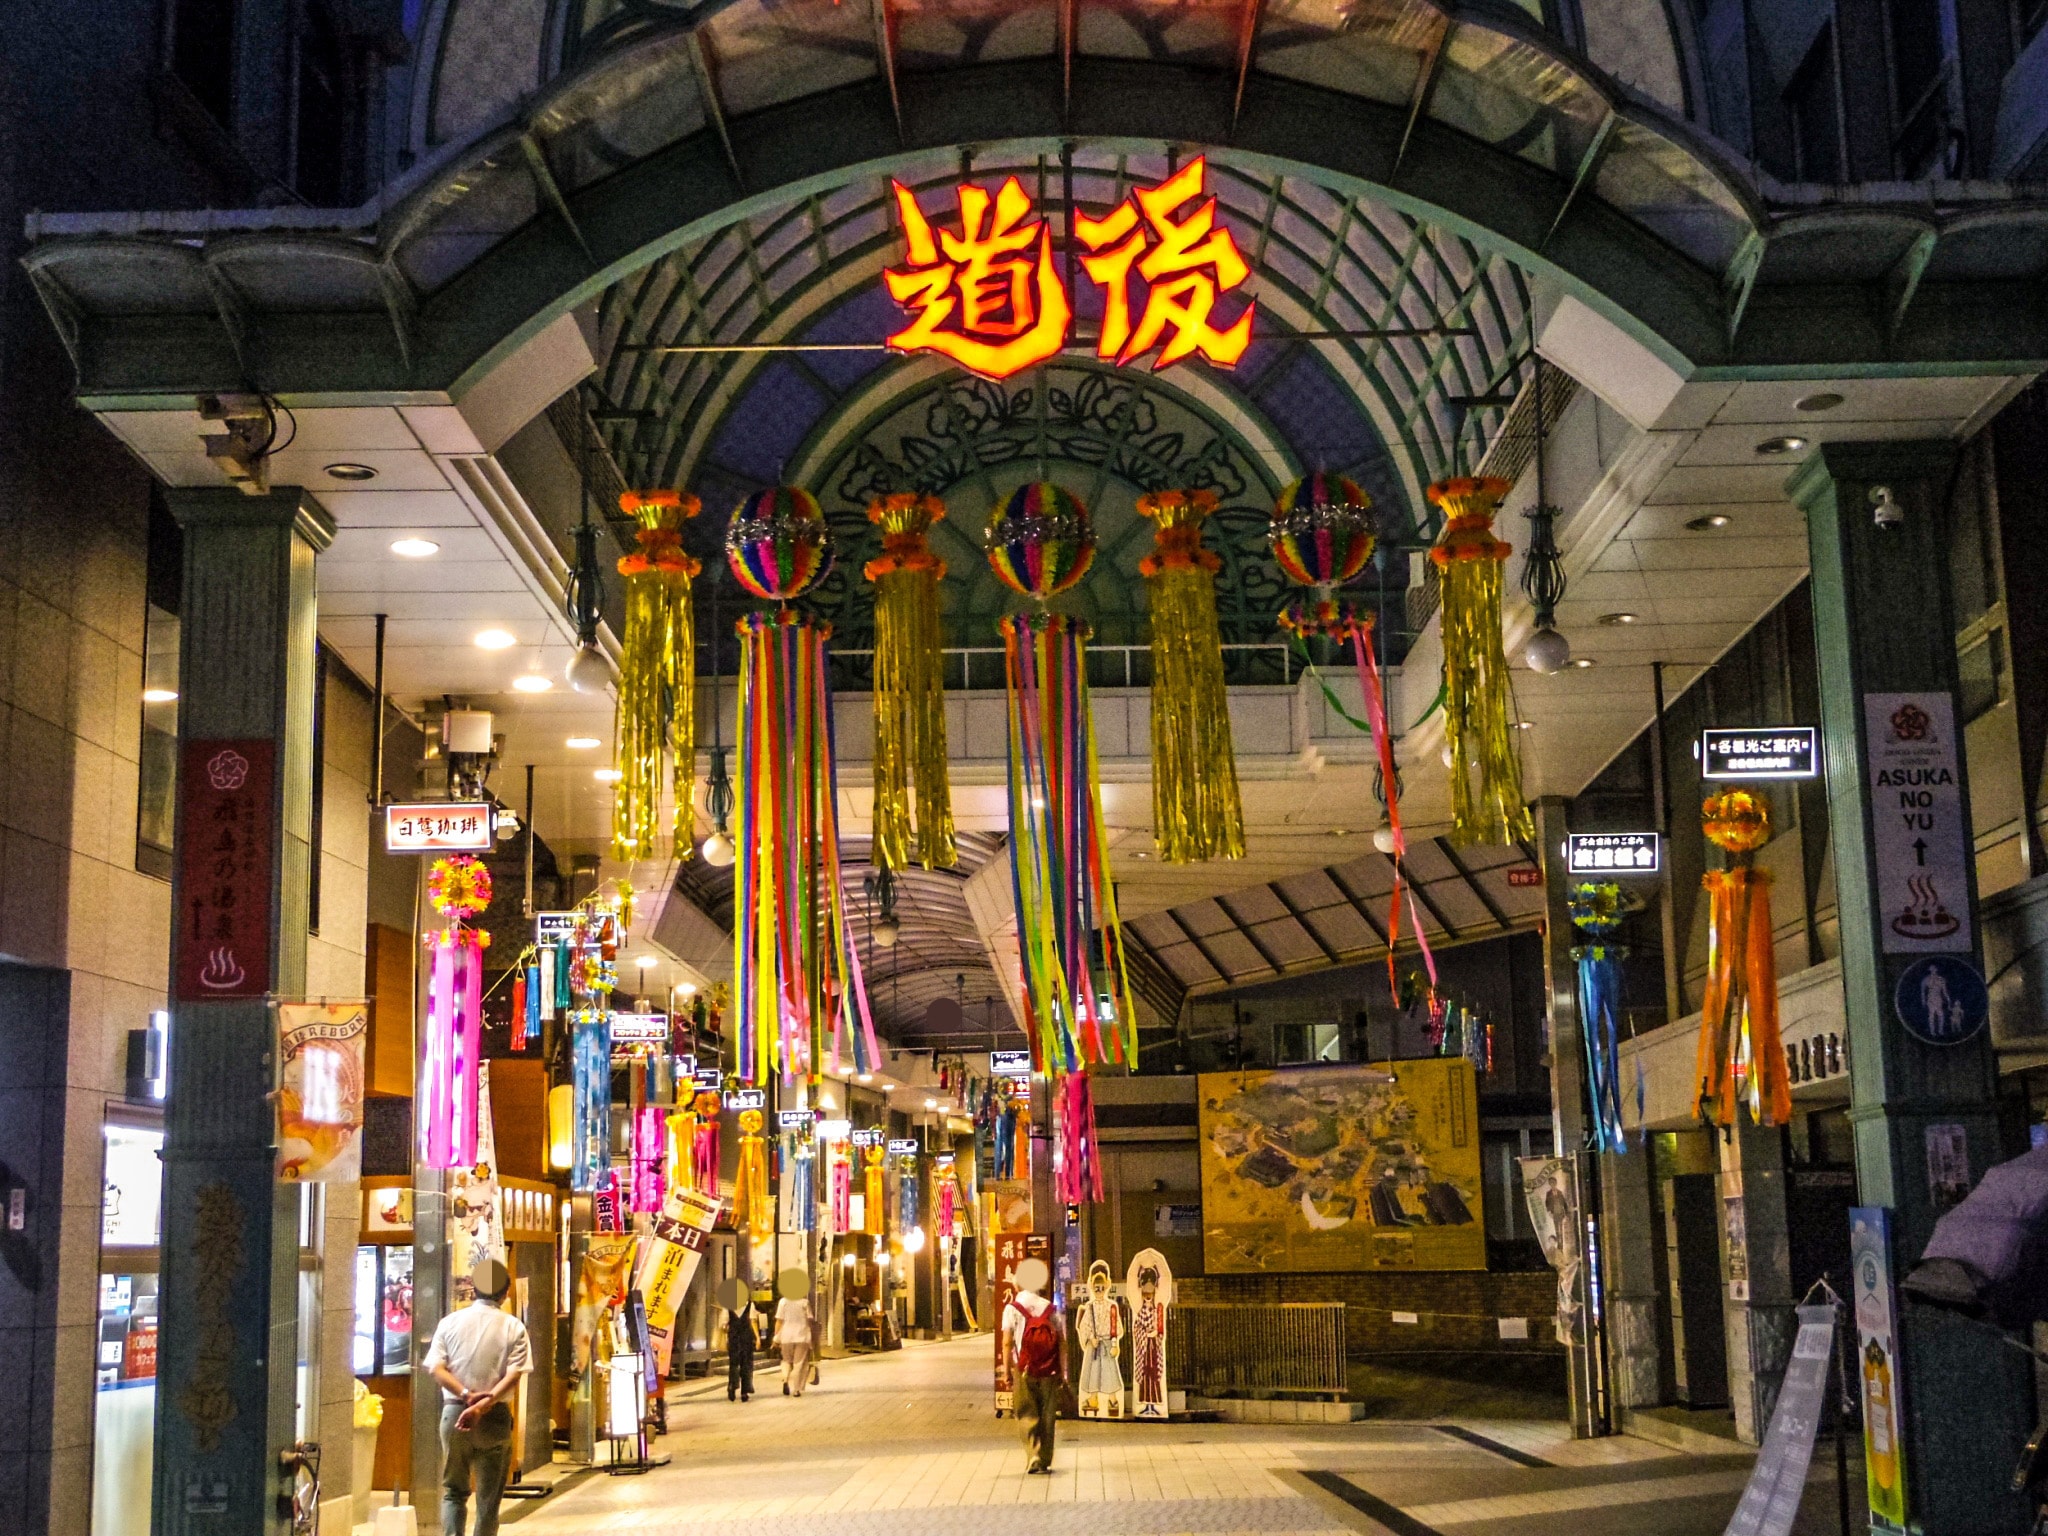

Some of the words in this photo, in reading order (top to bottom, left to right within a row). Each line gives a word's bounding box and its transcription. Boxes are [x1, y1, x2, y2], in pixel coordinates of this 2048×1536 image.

[885, 155, 1256, 380] 道後
[1877, 768, 1953, 787] ASUKA
[1900, 790, 1933, 809] NO
[399, 816, 479, 836] 白鷺珈琲
[1903, 813, 1934, 831] YU
[308, 1014, 366, 1039] REBORN
[663, 1221, 702, 1250] 本日
[645, 1247, 684, 1321] 泊まれます
